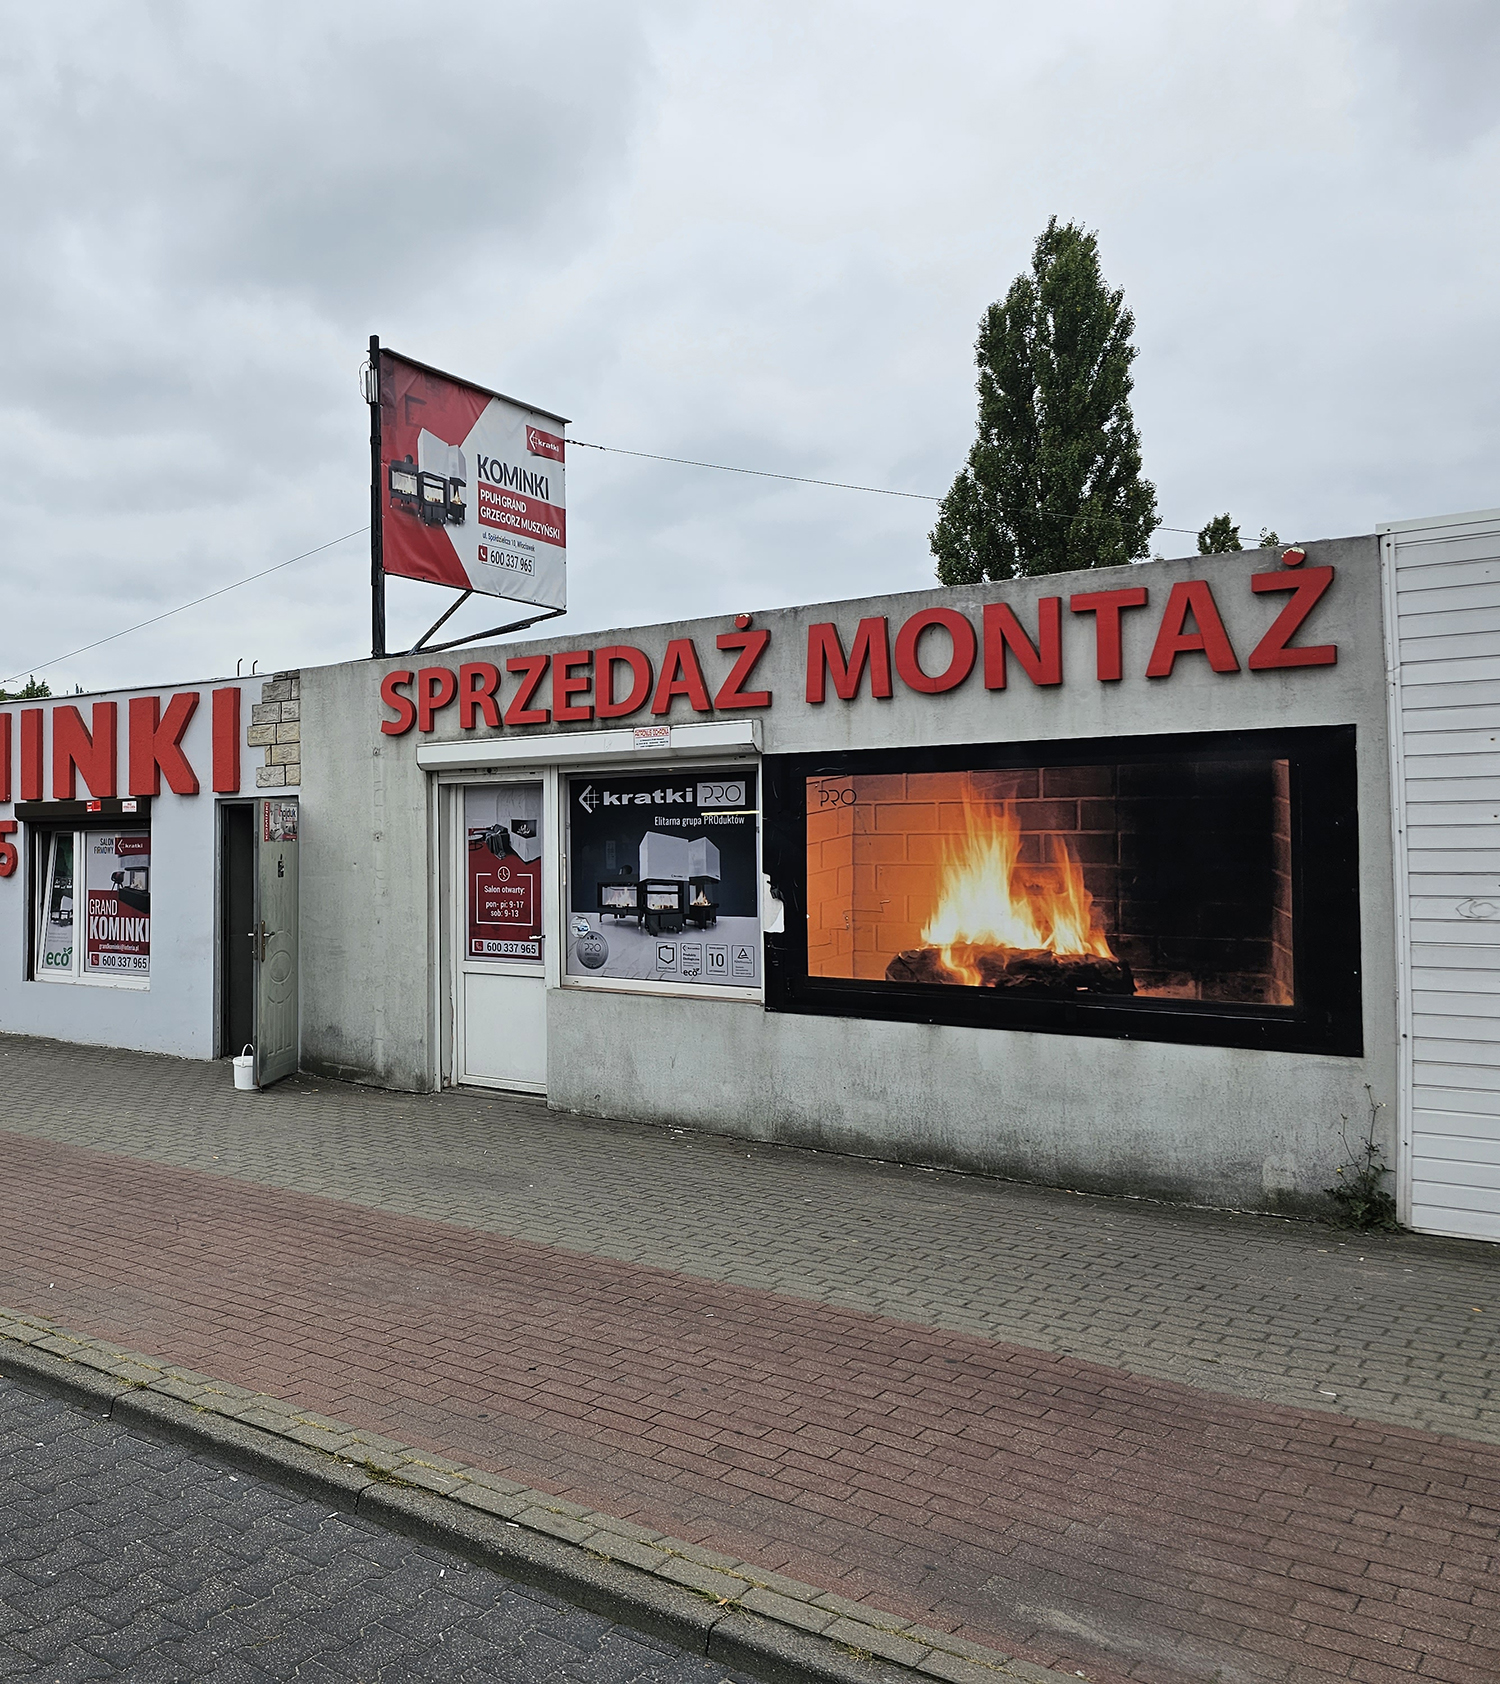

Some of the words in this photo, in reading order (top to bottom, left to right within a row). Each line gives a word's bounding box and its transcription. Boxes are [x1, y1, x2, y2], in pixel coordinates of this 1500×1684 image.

[538, 439, 560, 452] kratki
[477, 453, 549, 501] KOMINKI
[480, 489, 501, 506] PPUH
[501, 496, 527, 513] GRAND
[480, 506, 521, 528] GRZEGORZ
[521, 518, 560, 540] MUSZYŃSKI
[490, 550, 505, 566] 600
[505, 554, 519, 569] 337
[520, 557, 533, 573] 965
[380, 613, 773, 736] SPRZEDAŻ
[805, 547, 1338, 704] MONTAŻ
[0, 687, 241, 802] INKI
[602, 788, 693, 806] kratki
[702, 784, 742, 803] PRO
[818, 788, 857, 807] PRO
[654, 816, 681, 827] Elitarna
[681, 818, 702, 828] grupa
[703, 814, 745, 825] PROduktów
[100, 838, 114, 846] SALON
[484, 885, 501, 893] Salon
[501, 886, 526, 896] otwarty:
[89, 899, 118, 916] GRAND
[509, 900, 524, 909] 9-17
[490, 909, 503, 917] sob:
[504, 910, 519, 918] 9-13
[89, 916, 150, 942] KOMINKI
[487, 942, 502, 952] 600
[503, 943, 519, 953] 337
[520, 944, 536, 954] 965
[46, 952, 69, 967] eco
[102, 955, 115, 967] 600
[117, 956, 131, 968] 337
[133, 957, 147, 969] 965
[708, 953, 725, 967] 10
[683, 969, 698, 977] eco
